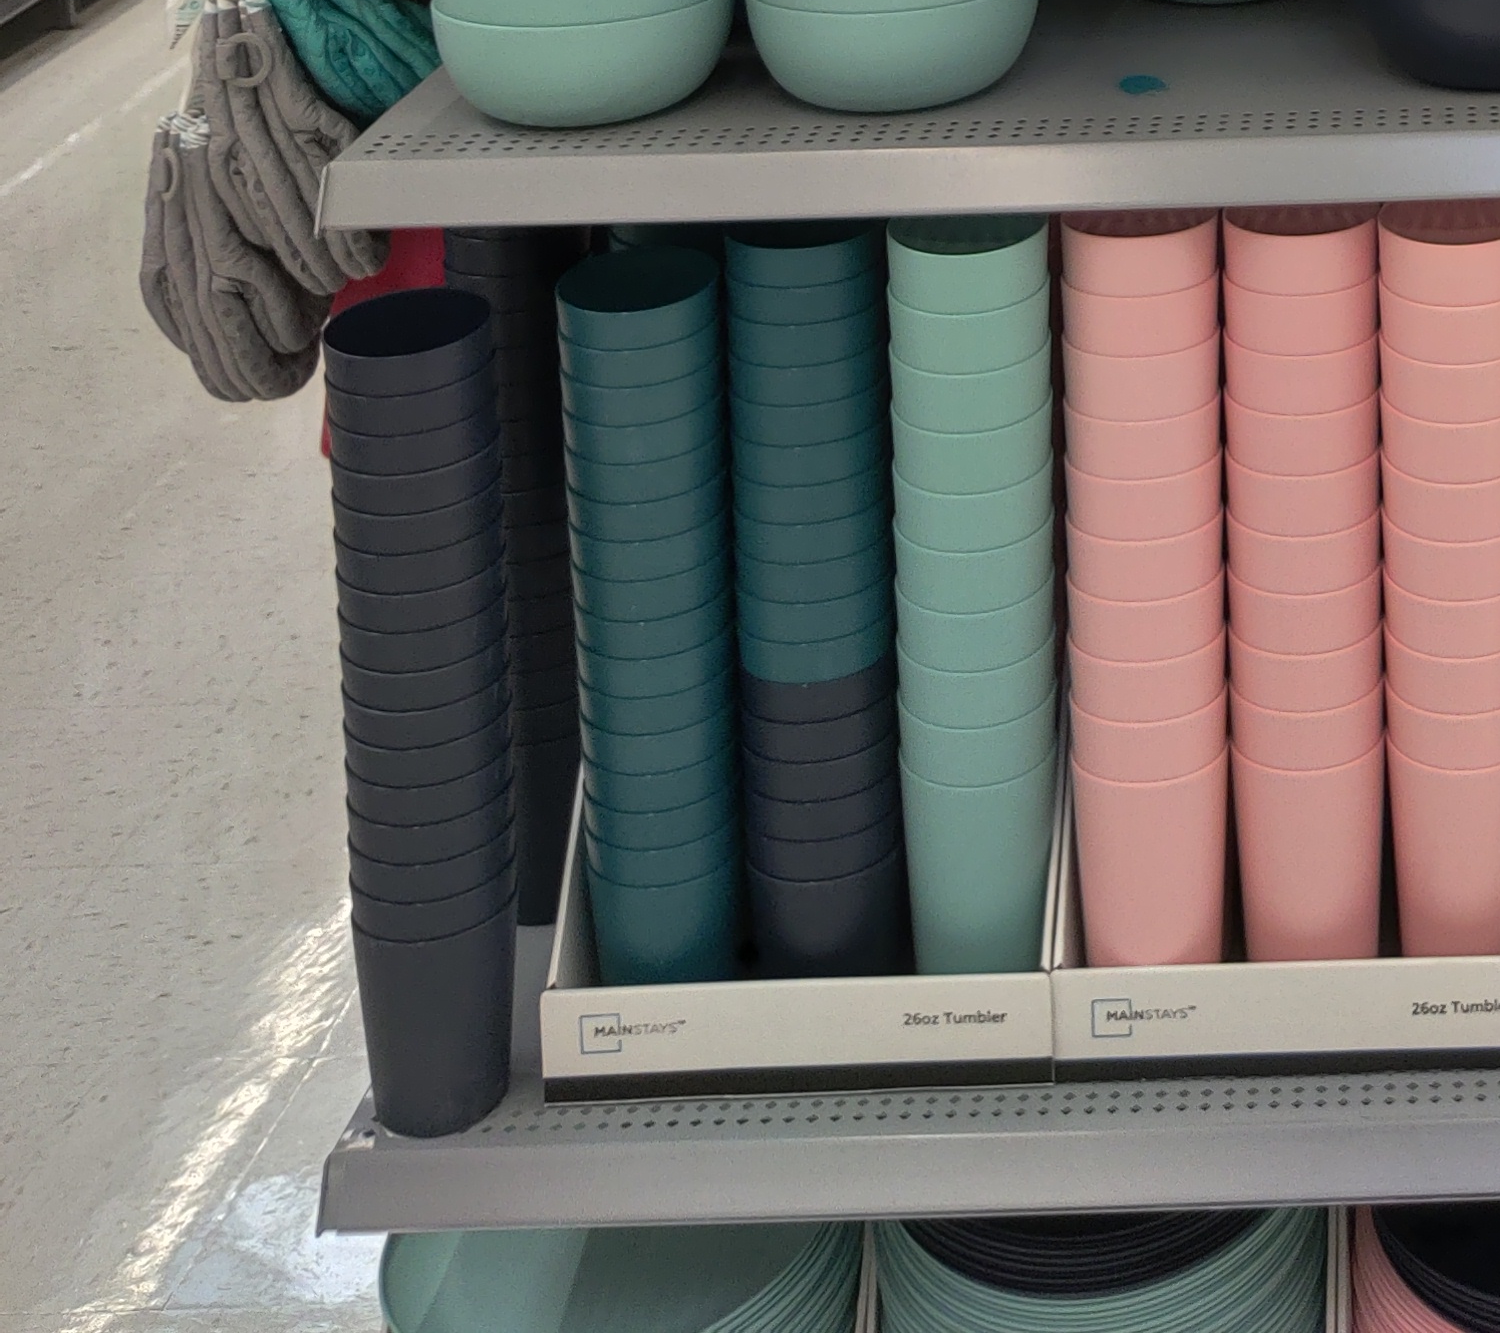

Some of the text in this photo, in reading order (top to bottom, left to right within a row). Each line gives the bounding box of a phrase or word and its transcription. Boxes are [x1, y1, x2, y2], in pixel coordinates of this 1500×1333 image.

[1411, 1001, 1448, 1016] 26oz
[902, 1010, 1008, 1027] 26oz Tumbler
